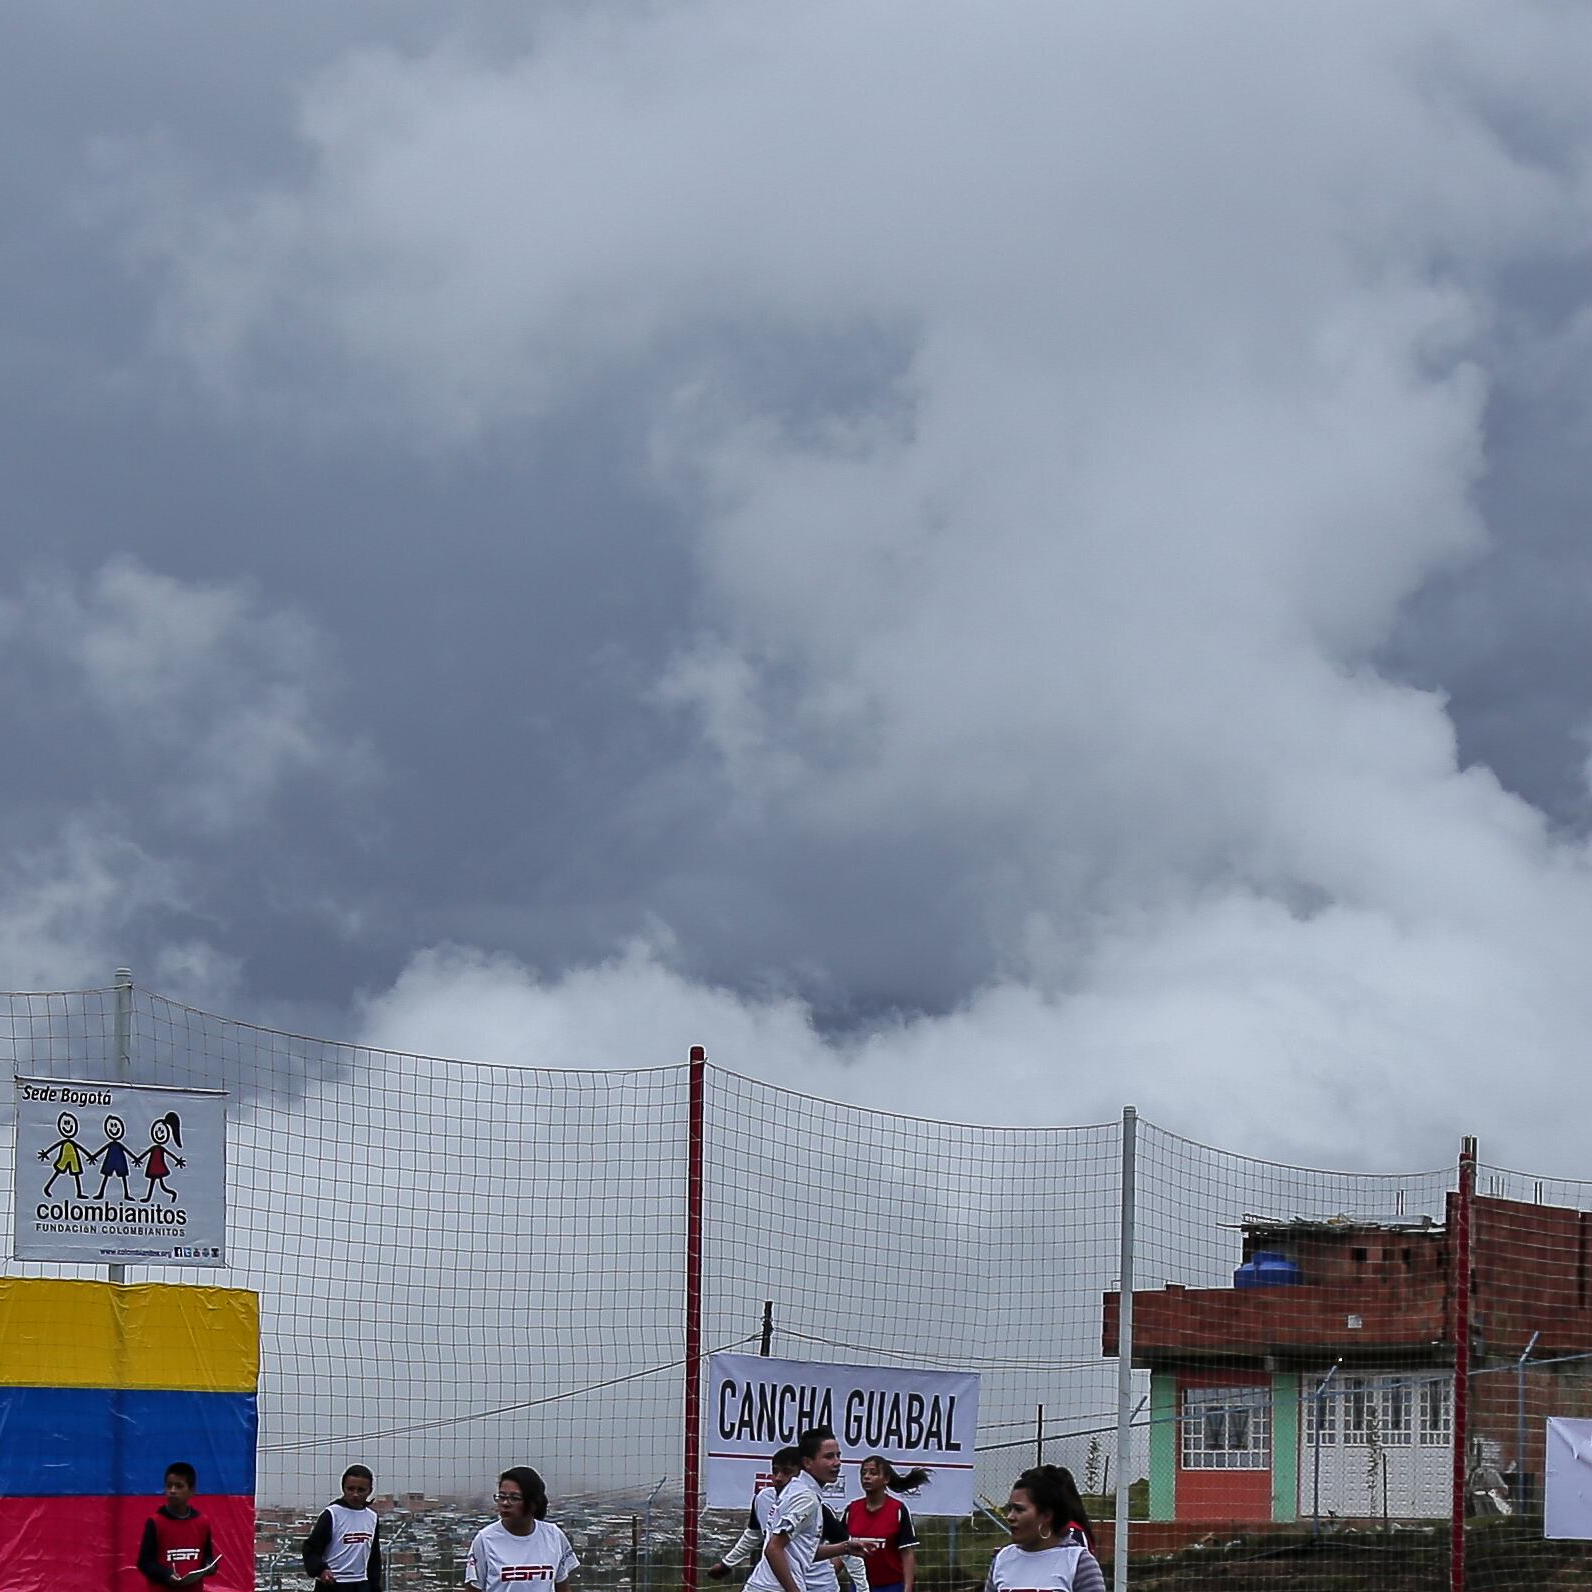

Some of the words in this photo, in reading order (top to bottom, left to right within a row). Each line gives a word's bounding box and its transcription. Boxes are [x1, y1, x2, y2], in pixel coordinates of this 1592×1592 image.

[22, 1085, 57, 1102] Sede
[61, 1088, 113, 1107] Bogotá
[36, 1200, 187, 1225] colombianitos
[101, 1226, 186, 1238] COLOMBIANITOS
[719, 1379, 834, 1443] CANCHA
[844, 1389, 962, 1451] GUABAL
[501, 1565, 554, 1582] ESPN
